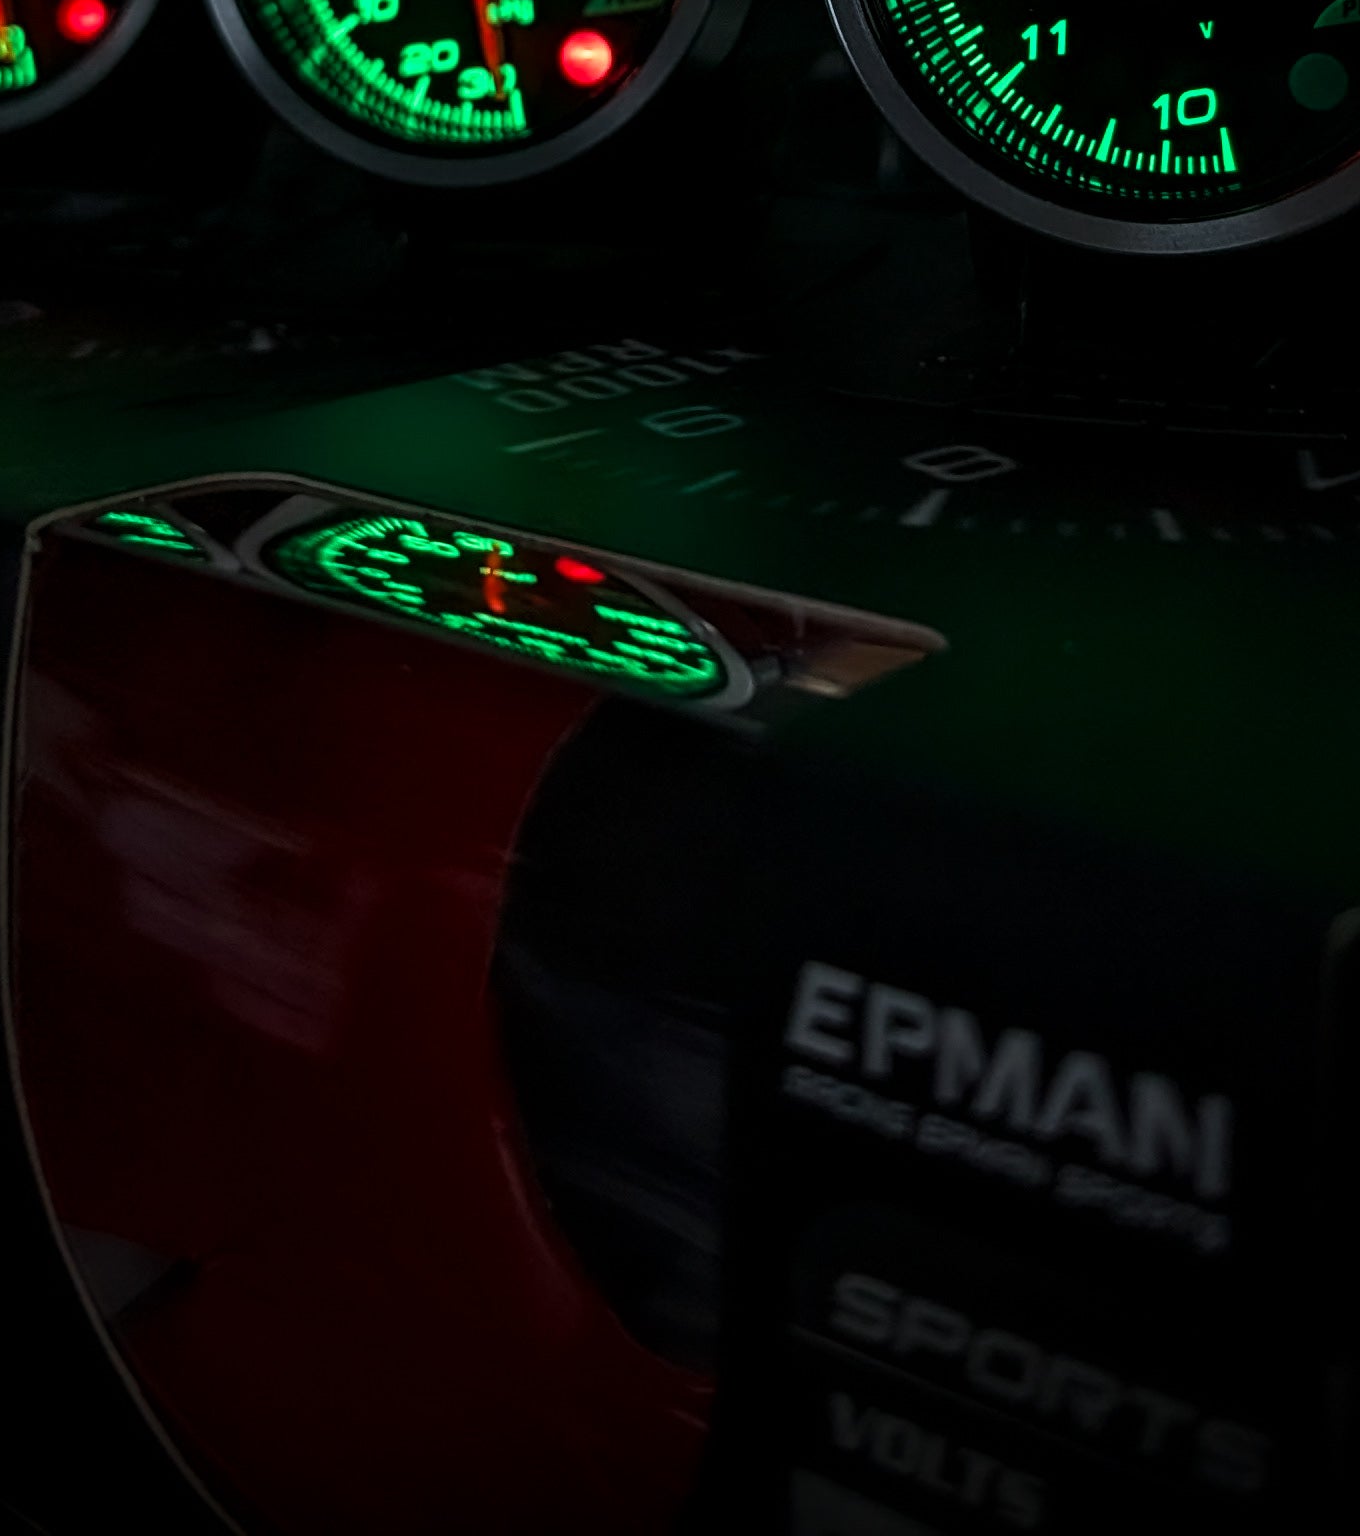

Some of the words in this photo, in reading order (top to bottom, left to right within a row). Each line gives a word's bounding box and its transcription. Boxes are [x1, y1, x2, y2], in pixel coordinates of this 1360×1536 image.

[398, 38, 460, 76] 20
[1021, 19, 1069, 62] 11
[1152, 87, 1219, 131] 10
[781, 959, 1236, 1200] EPMAN
[828, 1271, 1275, 1496] SPORTS
[825, 1390, 1048, 1530] VOLTS
